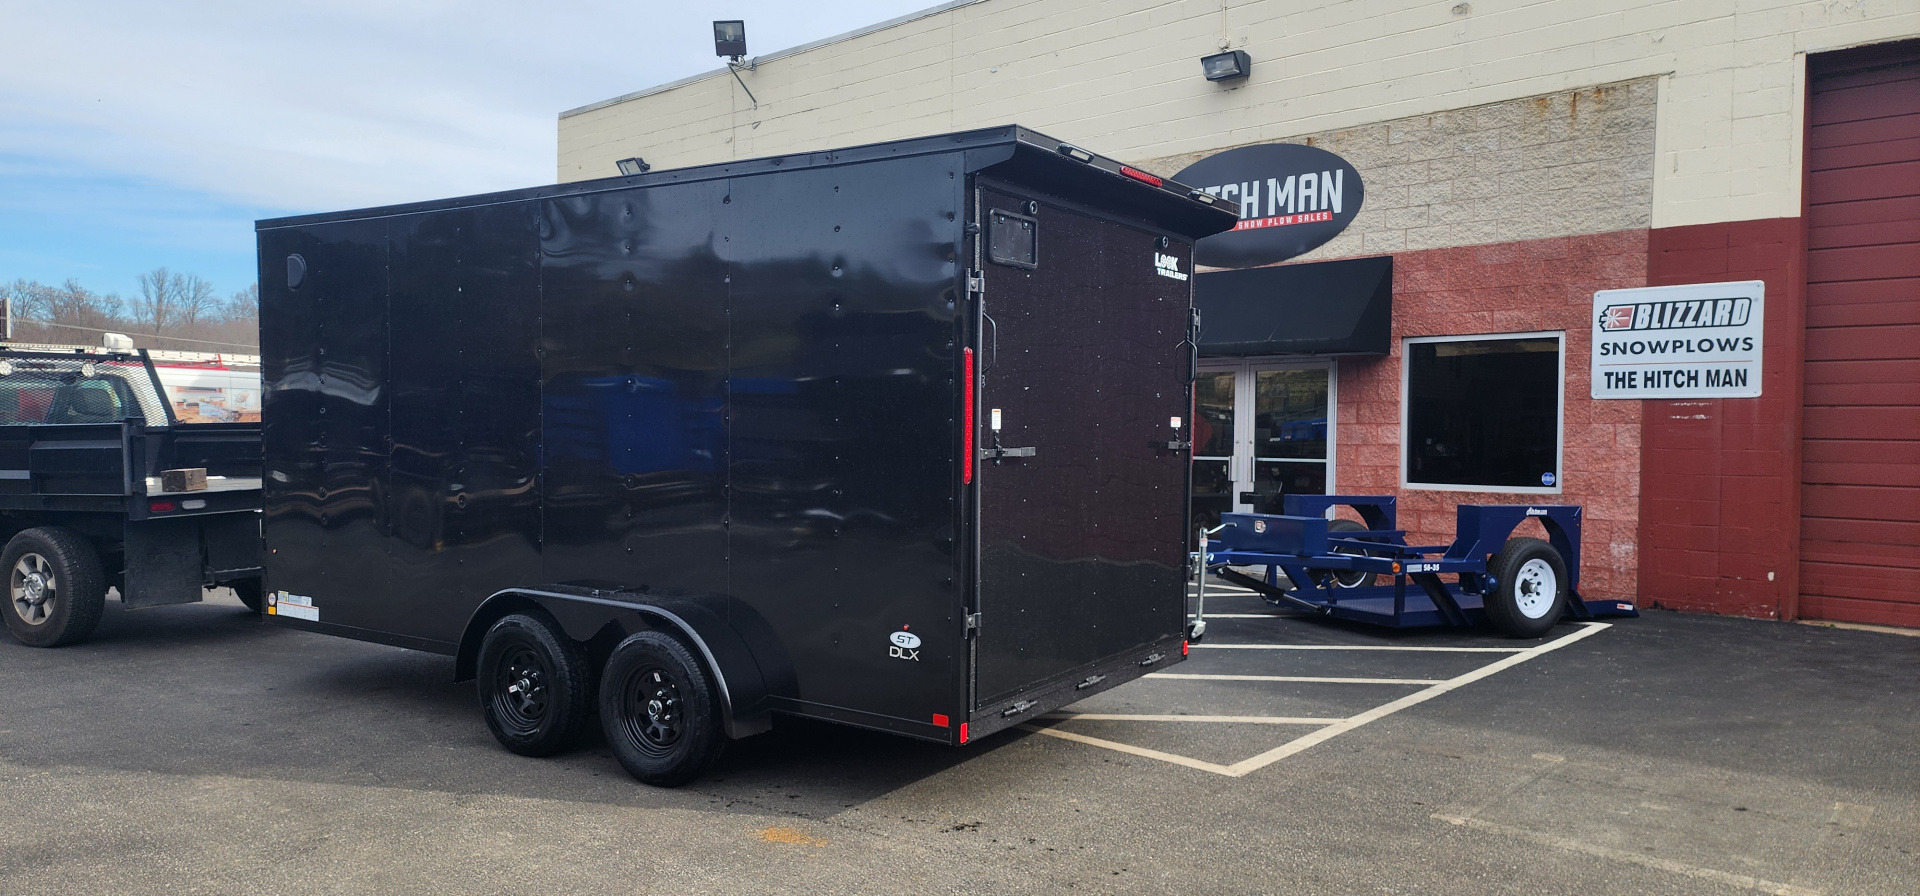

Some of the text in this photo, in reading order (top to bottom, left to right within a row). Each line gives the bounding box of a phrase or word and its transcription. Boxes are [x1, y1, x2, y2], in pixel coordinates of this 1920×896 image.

[1267, 169, 1344, 216] MAN
[1238, 212, 1328, 230] SNOW PLOW SALES
[1154, 252, 1179, 272] LOOK
[1157, 267, 1188, 281] TRAILERS
[1634, 298, 1751, 330] BLIZZARD
[1600, 337, 1754, 356] SNOWPLOWS
[1604, 368, 1748, 389] THE HITCH MAN
[896, 635, 914, 644] ST
[889, 646, 919, 661] DLX
